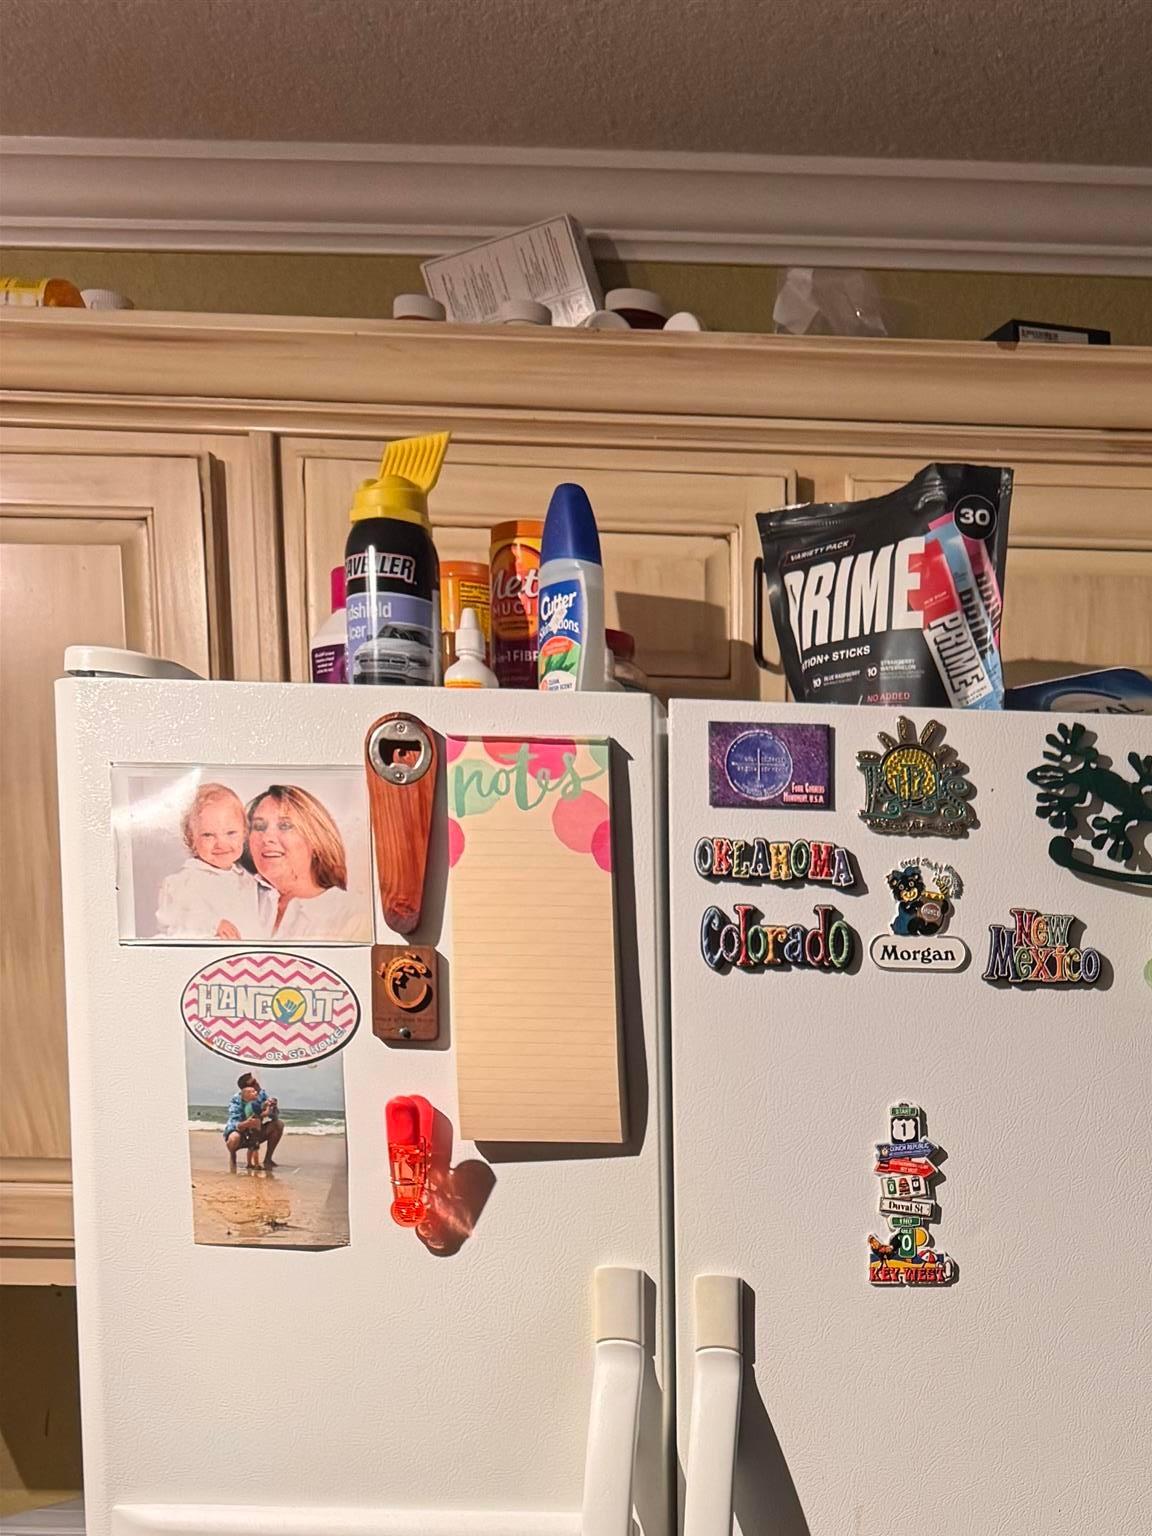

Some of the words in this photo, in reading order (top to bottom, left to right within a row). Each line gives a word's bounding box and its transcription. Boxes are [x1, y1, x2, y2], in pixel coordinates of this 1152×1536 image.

[959, 508, 991, 526] 30
[791, 545, 825, 561] VARIETY
[825, 540, 850, 551] PACK
[541, 591, 577, 621] Cutter
[783, 536, 926, 664] PRIME
[832, 645, 871, 661] STICKS
[927, 615, 984, 694] PRIME
[867, 666, 878, 678] 10
[812, 678, 822, 689] 10
[867, 694, 879, 702] NO
[880, 691, 911, 701] ADDED
[454, 743, 606, 818] notes
[694, 837, 854, 887] OKLAHOMA
[701, 904, 850, 967] Colorado
[1010, 908, 1075, 948] New
[880, 944, 956, 964] Morgan
[982, 925, 1101, 983] Mexico
[213, 1037, 241, 1055] NICE
[265, 1051, 285, 1061] OR
[288, 1048, 308, 1060] GO
[309, 1027, 347, 1055] HOME
[900, 1122, 907, 1137] 1
[888, 1201, 913, 1212] Duval
[915, 1205, 923, 1213] St
[901, 1235, 912, 1252] 0
[869, 1267, 901, 1282] KEY
[905, 1267, 945, 1282] WEST
